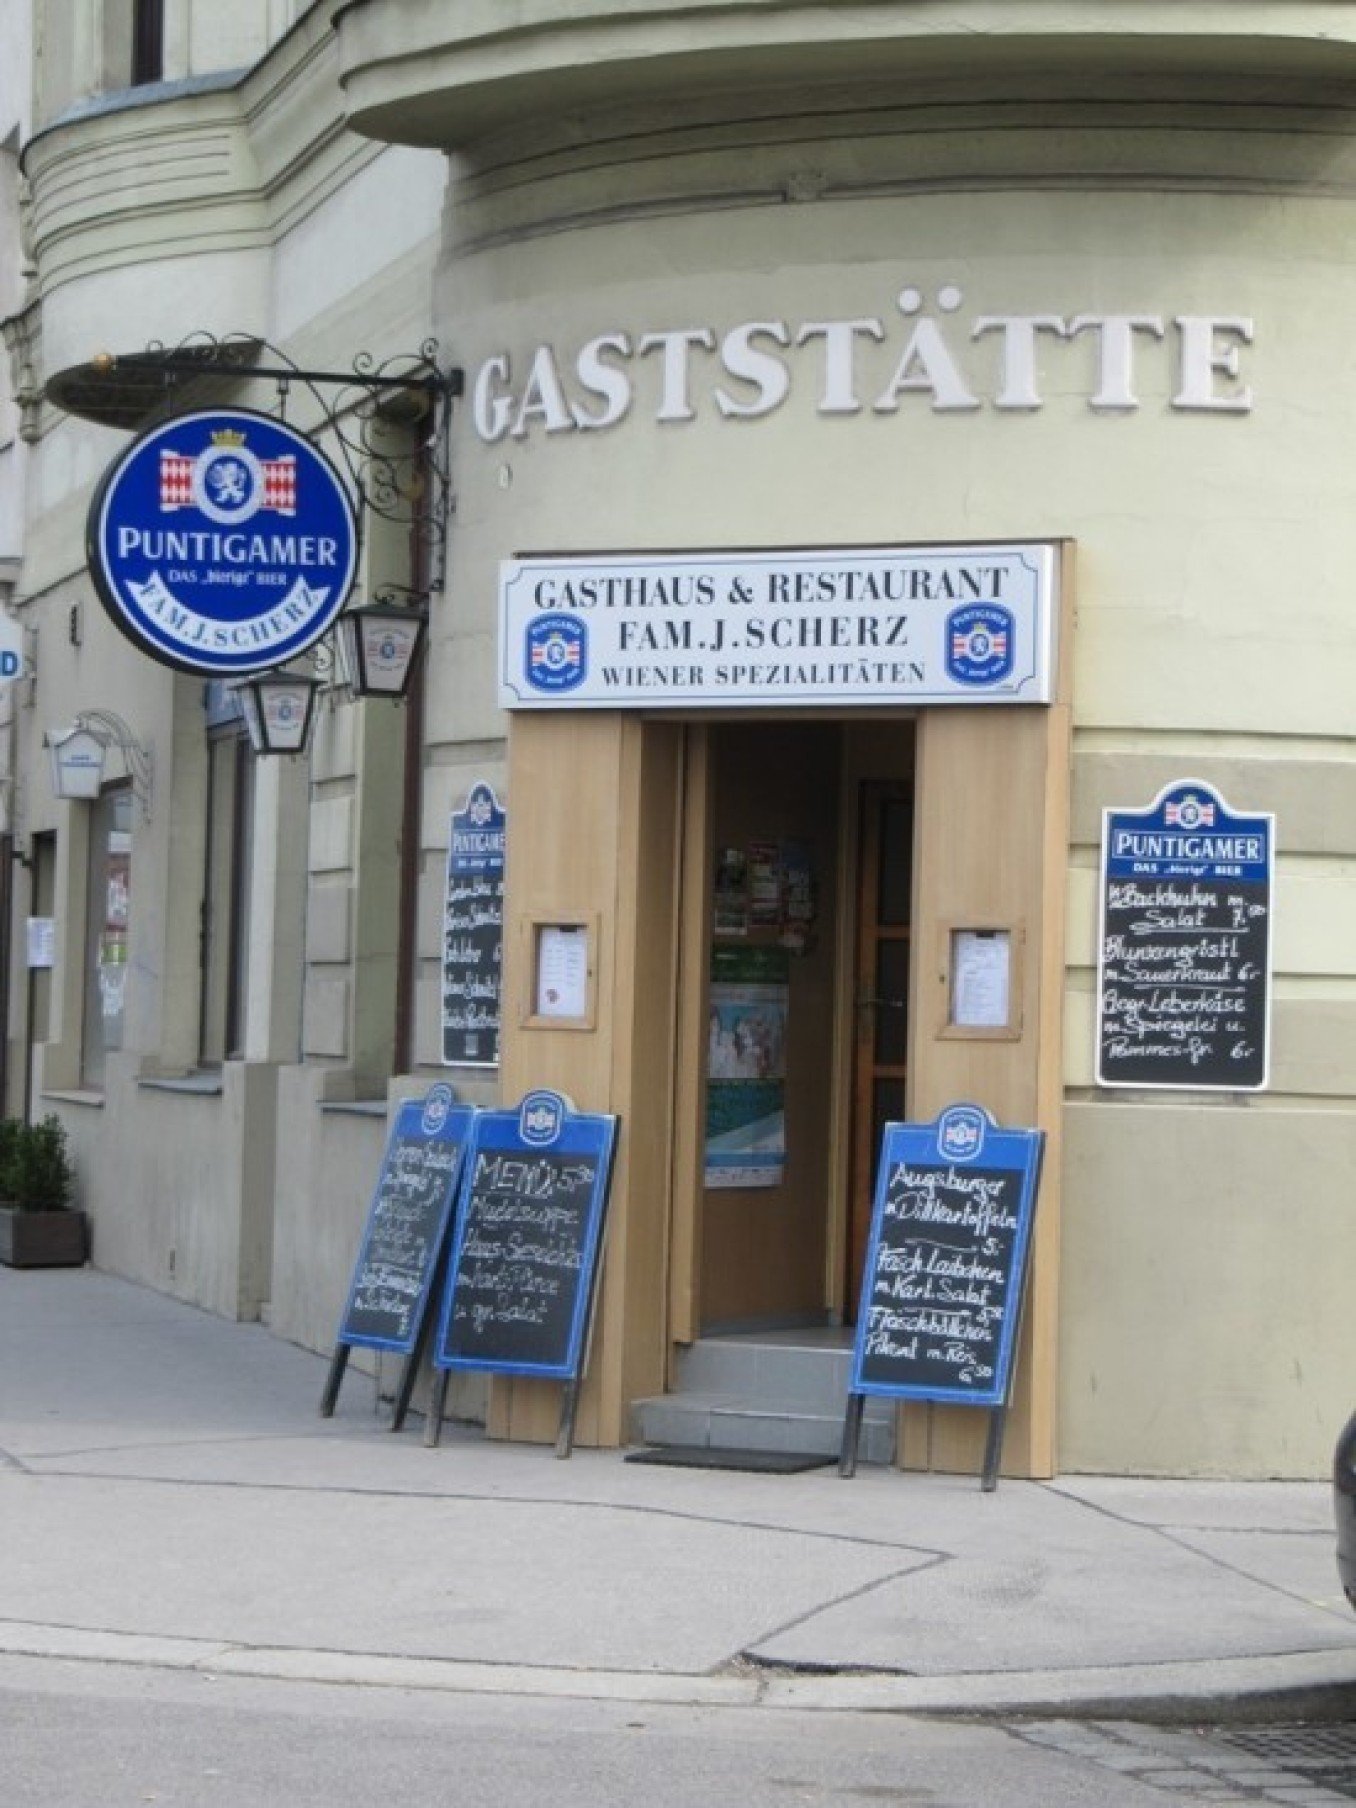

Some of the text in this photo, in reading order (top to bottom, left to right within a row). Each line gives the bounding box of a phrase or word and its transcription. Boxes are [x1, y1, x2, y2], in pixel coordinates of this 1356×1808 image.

[473, 285, 1256, 444] GASTSTÄTTE
[118, 527, 338, 566] PUNTIGAMER
[534, 567, 1009, 609] GASTHAUS & RESTAURANT
[602, 665, 704, 687] WIENER
[714, 658, 927, 687] SPEZIALITÄTEN
[1116, 833, 1260, 860] PUNTIGAMER
[1145, 908, 1207, 928] Salat
